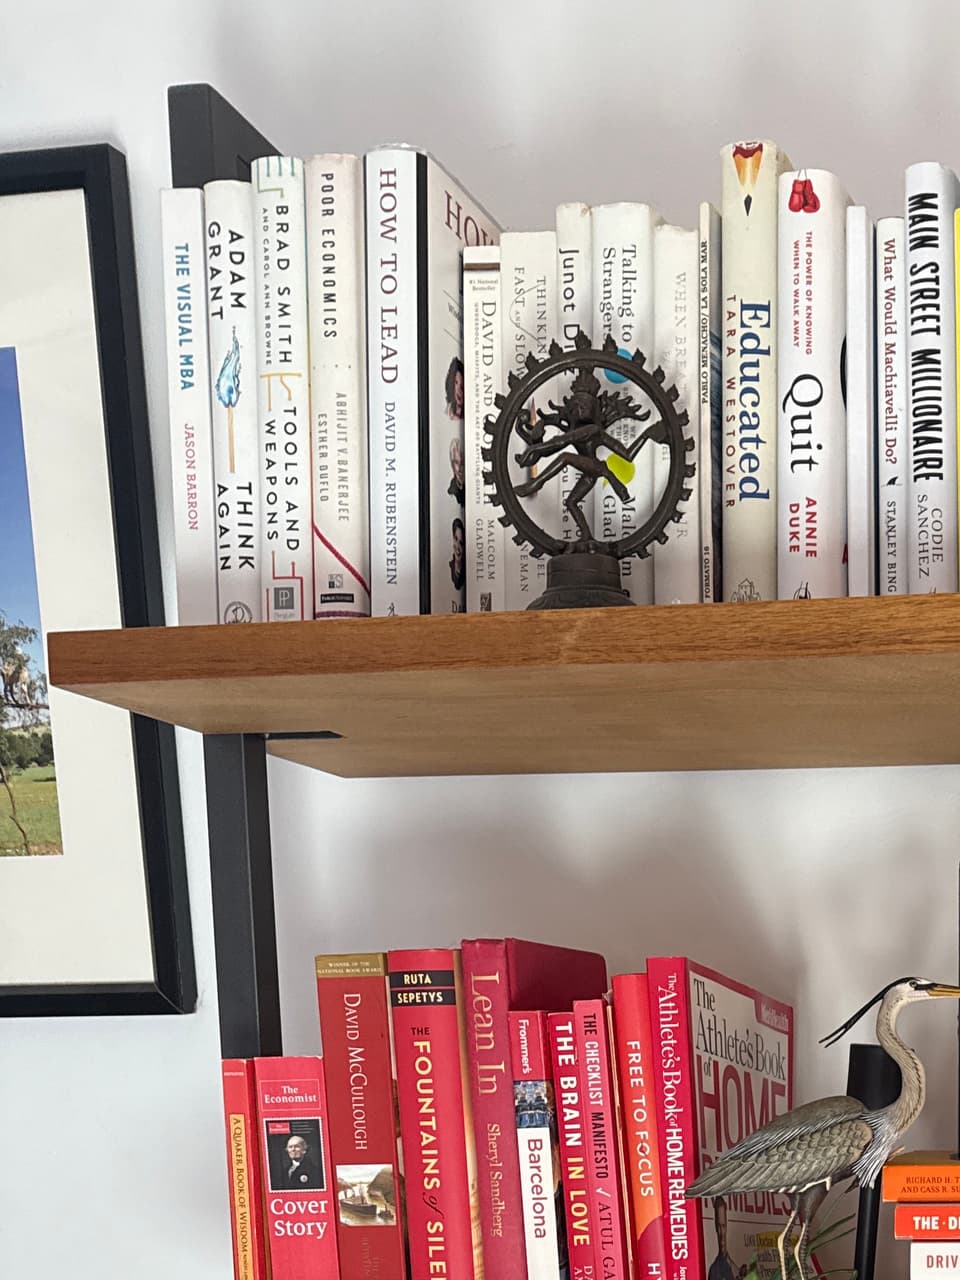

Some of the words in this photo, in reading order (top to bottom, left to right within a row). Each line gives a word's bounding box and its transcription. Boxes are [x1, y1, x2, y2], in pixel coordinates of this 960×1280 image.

[321, 173, 334, 216] POOR
[379, 168, 397, 244] HOW
[907, 192, 939, 249] MAIN
[175, 243, 189, 280] THE
[276, 205, 289, 271] BRAD
[883, 238, 895, 281] What
[208, 222, 224, 320] GRANT
[228, 230, 247, 309] ADAM
[322, 229, 337, 339] ECONOMICS
[380, 253, 398, 294] TO
[806, 288, 812, 301] OF
[909, 260, 940, 336] STREET
[177, 284, 191, 346] VISUAL
[278, 287, 292, 364] SMITH
[725, 295, 735, 358] TARA
[805, 304, 813, 356] KNOWING
[884, 284, 896, 336] Would
[180, 353, 194, 391] MBA
[381, 306, 399, 384] LEAD
[739, 300, 770, 502] Educated
[884, 341, 897, 433] Machiavelli
[911, 348, 944, 481] MILLIONAIRE
[183, 423, 197, 468] JASON
[283, 406, 298, 486] TOOLS
[726, 377, 734, 508] WESTOVER
[782, 373, 824, 473] Quit
[885, 438, 898, 465] Do?
[186, 473, 199, 530] BARRON
[266, 420, 279, 540] WEAPONS
[217, 484, 232, 570] AGAIN
[237, 483, 255, 569] THINK
[285, 501, 299, 551] AND
[790, 503, 800, 553] DUKE
[804, 497, 817, 558] ANNIE
[397, 992, 443, 1003] SEPETYS
[404, 974, 432, 984] RUTA
[411, 1027, 430, 1037] THE
[469, 971, 499, 1051] Lean
[583, 1013, 596, 1037] THE
[555, 1021, 573, 1067] THE
[626, 1040, 642, 1089] FREE
[264, 1093, 317, 1104] Economist
[282, 1085, 299, 1094] The
[477, 1060, 505, 1095] In
[585, 1041, 603, 1106] CHECKLIST
[413, 1040, 440, 1191] FOUNTAINS
[560, 1076, 581, 1147] BRAIN
[632, 1095, 647, 1123] TO
[568, 1157, 584, 1180] IN
[592, 1111, 608, 1179] MANIFESTO
[635, 1130, 654, 1197] FOCUS
[271, 1198, 328, 1216] Cover
[424, 1193, 443, 1220] of
[527, 1139, 546, 1239] Barcelona
[274, 1219, 328, 1239] Story
[570, 1189, 590, 1247] LOVE
[913, 1216, 939, 1230] THE
